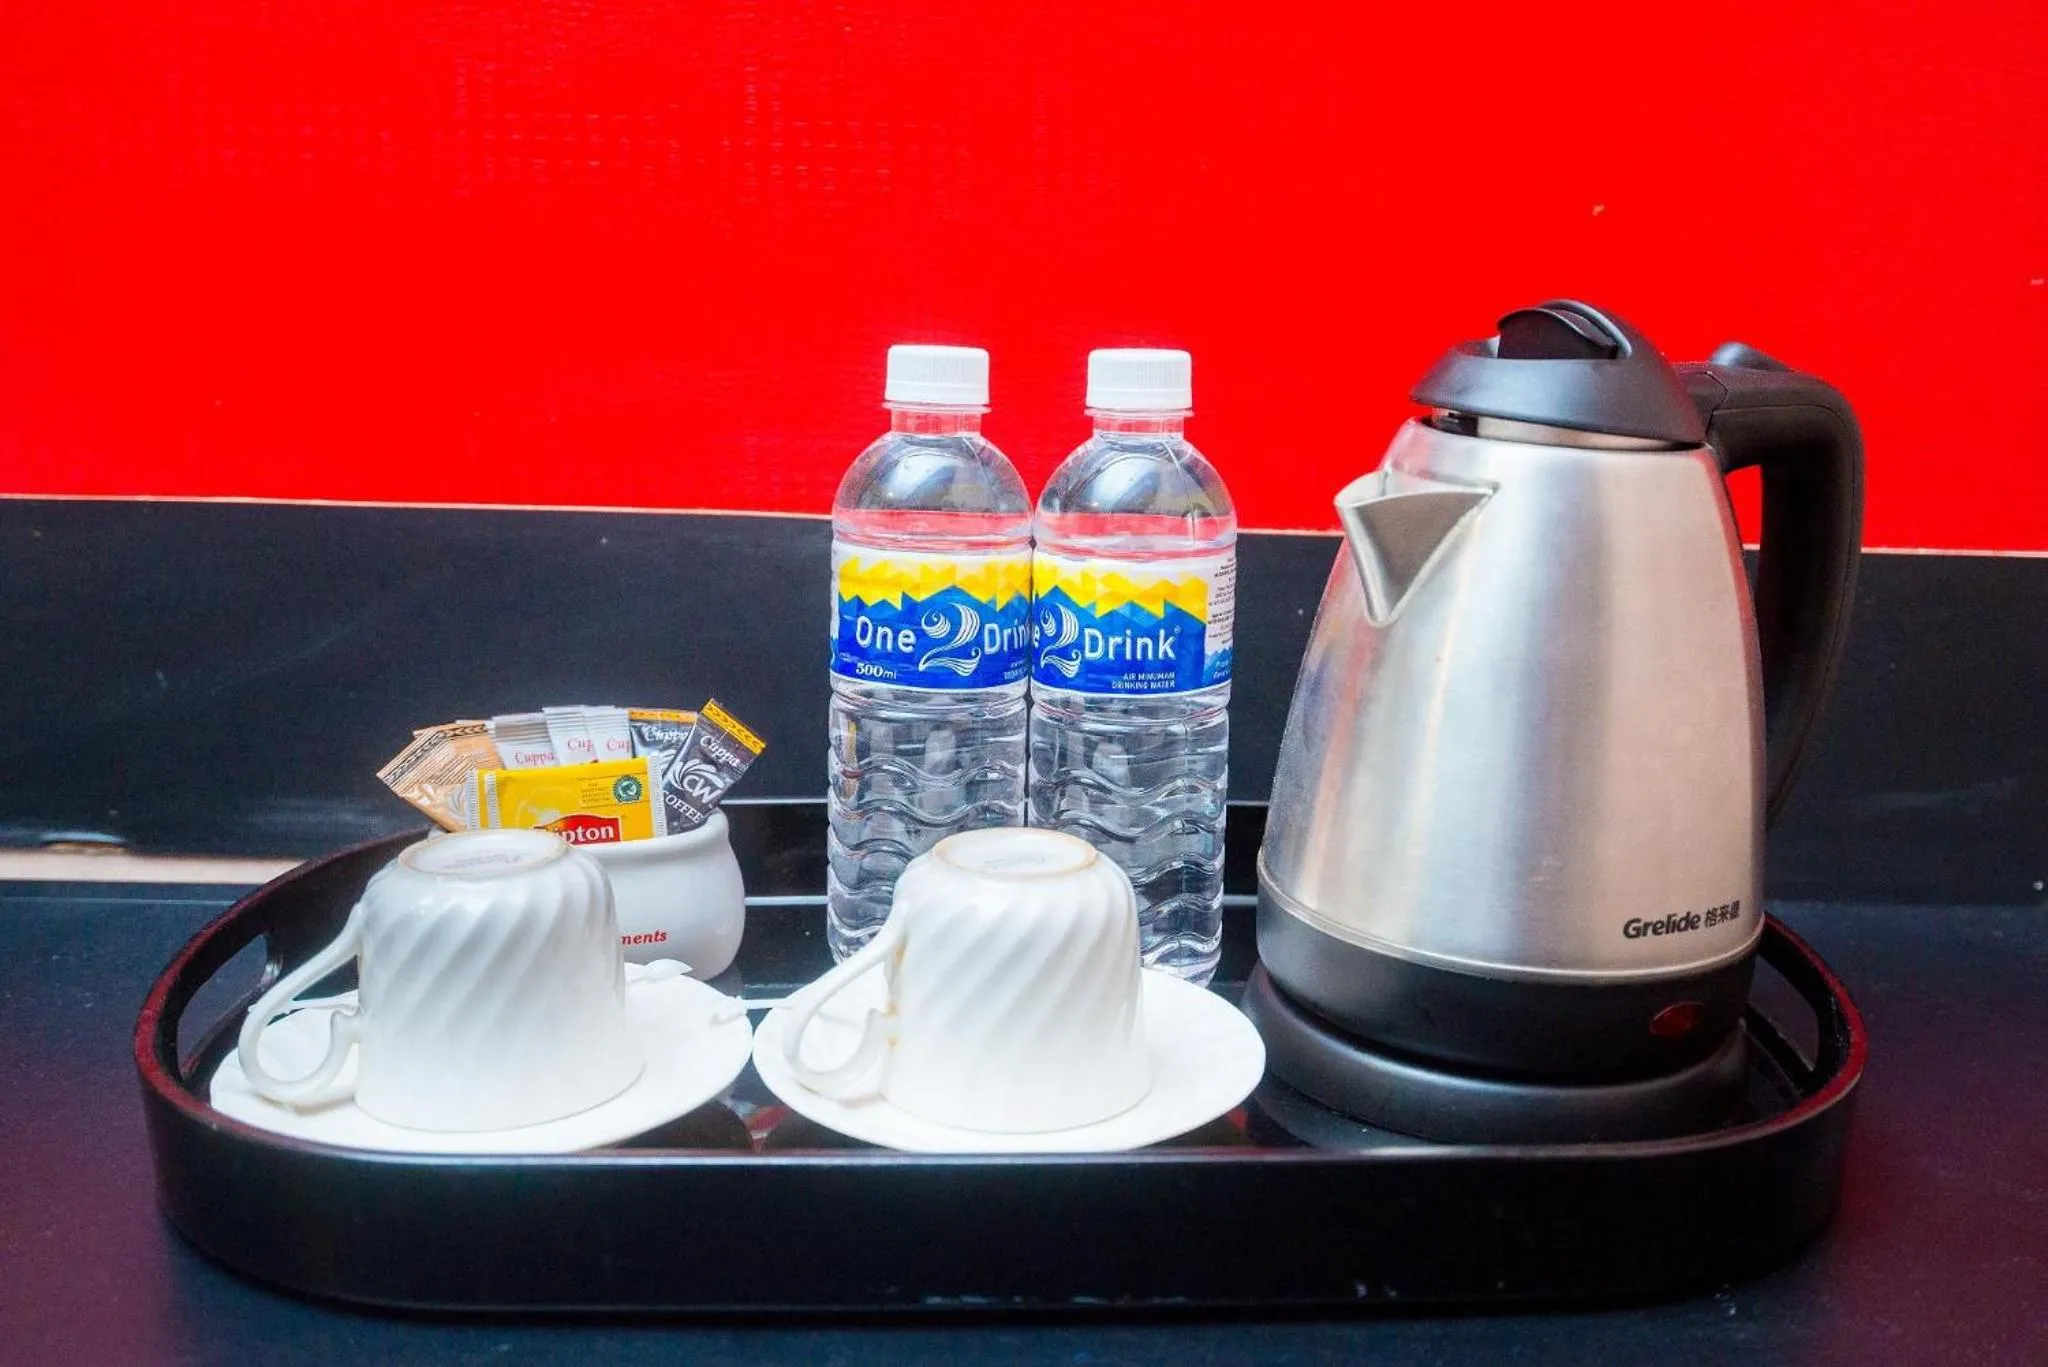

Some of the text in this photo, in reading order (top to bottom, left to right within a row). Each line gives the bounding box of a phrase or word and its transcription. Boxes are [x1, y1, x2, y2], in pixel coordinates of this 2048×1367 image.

[855, 615, 916, 653] One
[983, 618, 1030, 655] Drin
[1083, 627, 1177, 661] Drink
[855, 661, 897, 680] 500ml
[1111, 680, 1176, 689] DRINKING WATER
[514, 750, 556, 766] Cuppa
[700, 734, 741, 767] Cuppa
[662, 790, 704, 824] OFFEE
